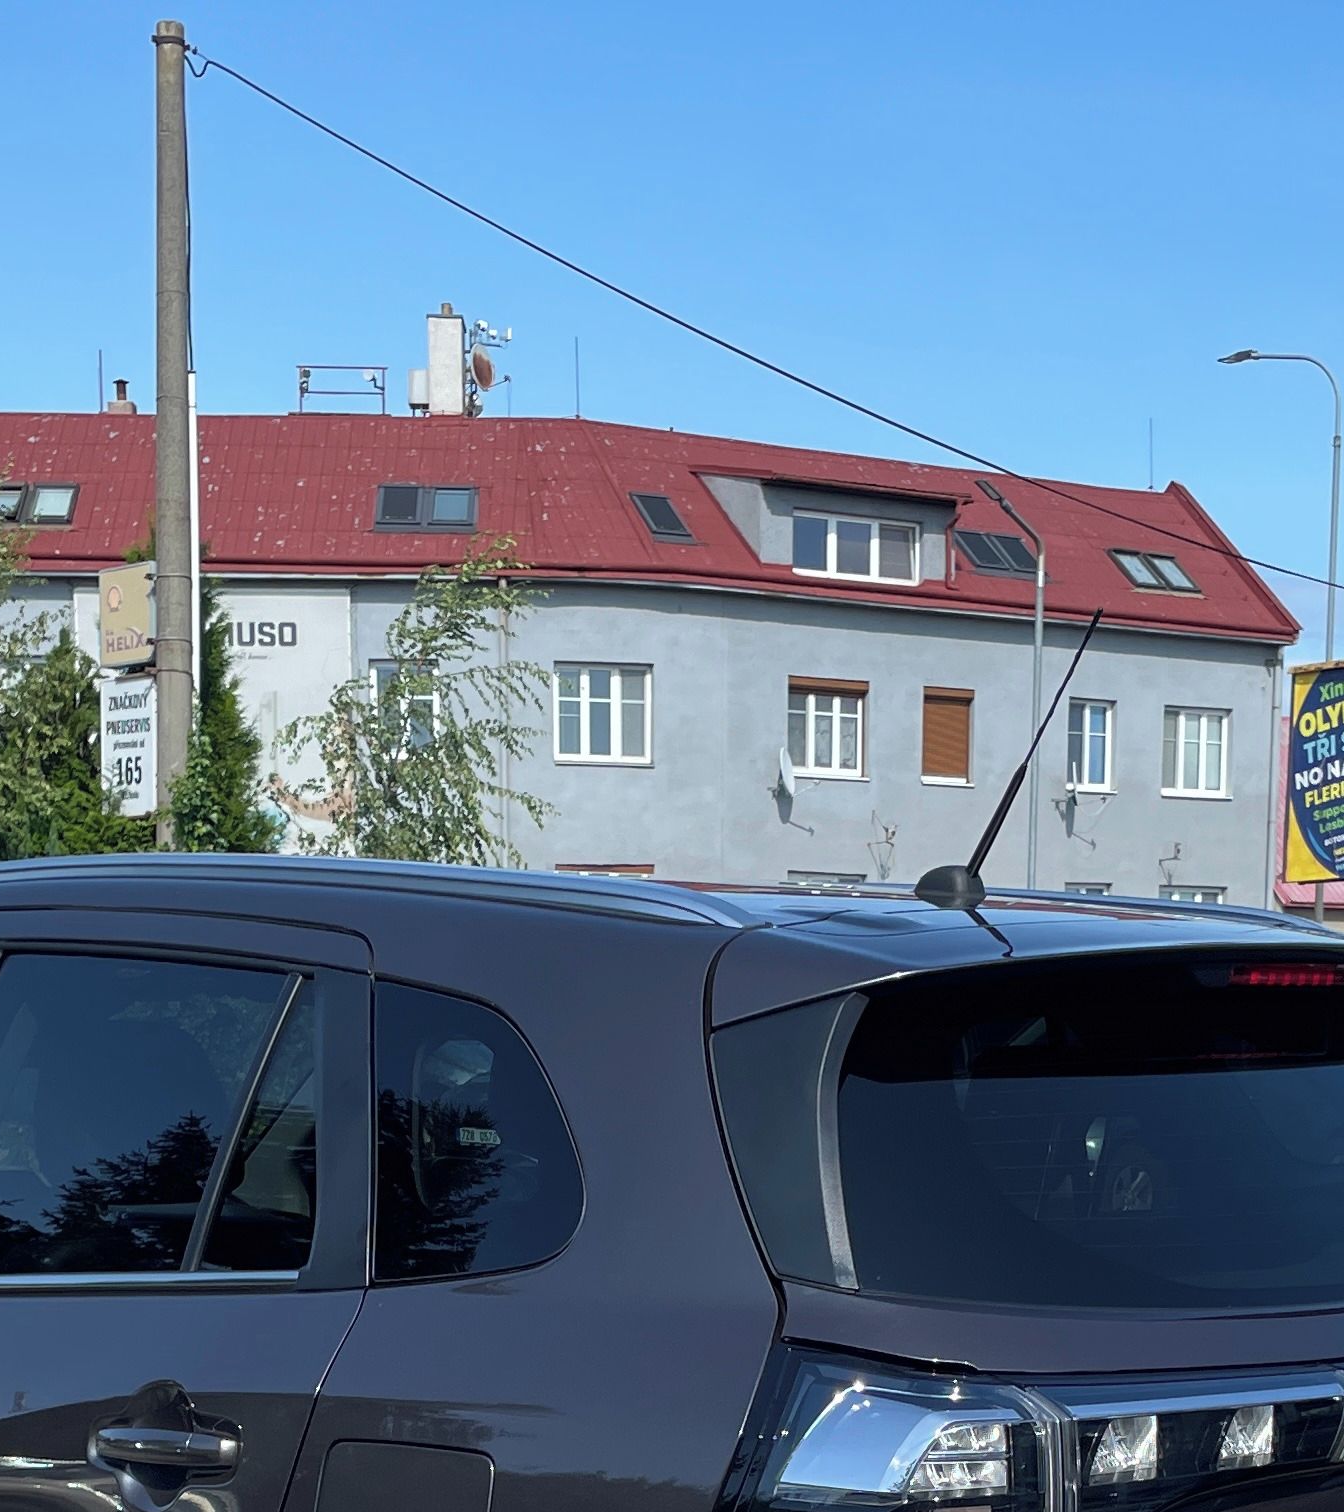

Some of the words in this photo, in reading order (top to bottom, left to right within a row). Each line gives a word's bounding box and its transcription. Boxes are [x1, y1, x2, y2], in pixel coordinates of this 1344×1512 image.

[106, 633, 145, 653] HELIX
[106, 717, 151, 735] PNEUSERVIS
[1303, 733, 1336, 764] TŘI
[115, 756, 142, 786] 165
[1294, 767, 1324, 790] NO
